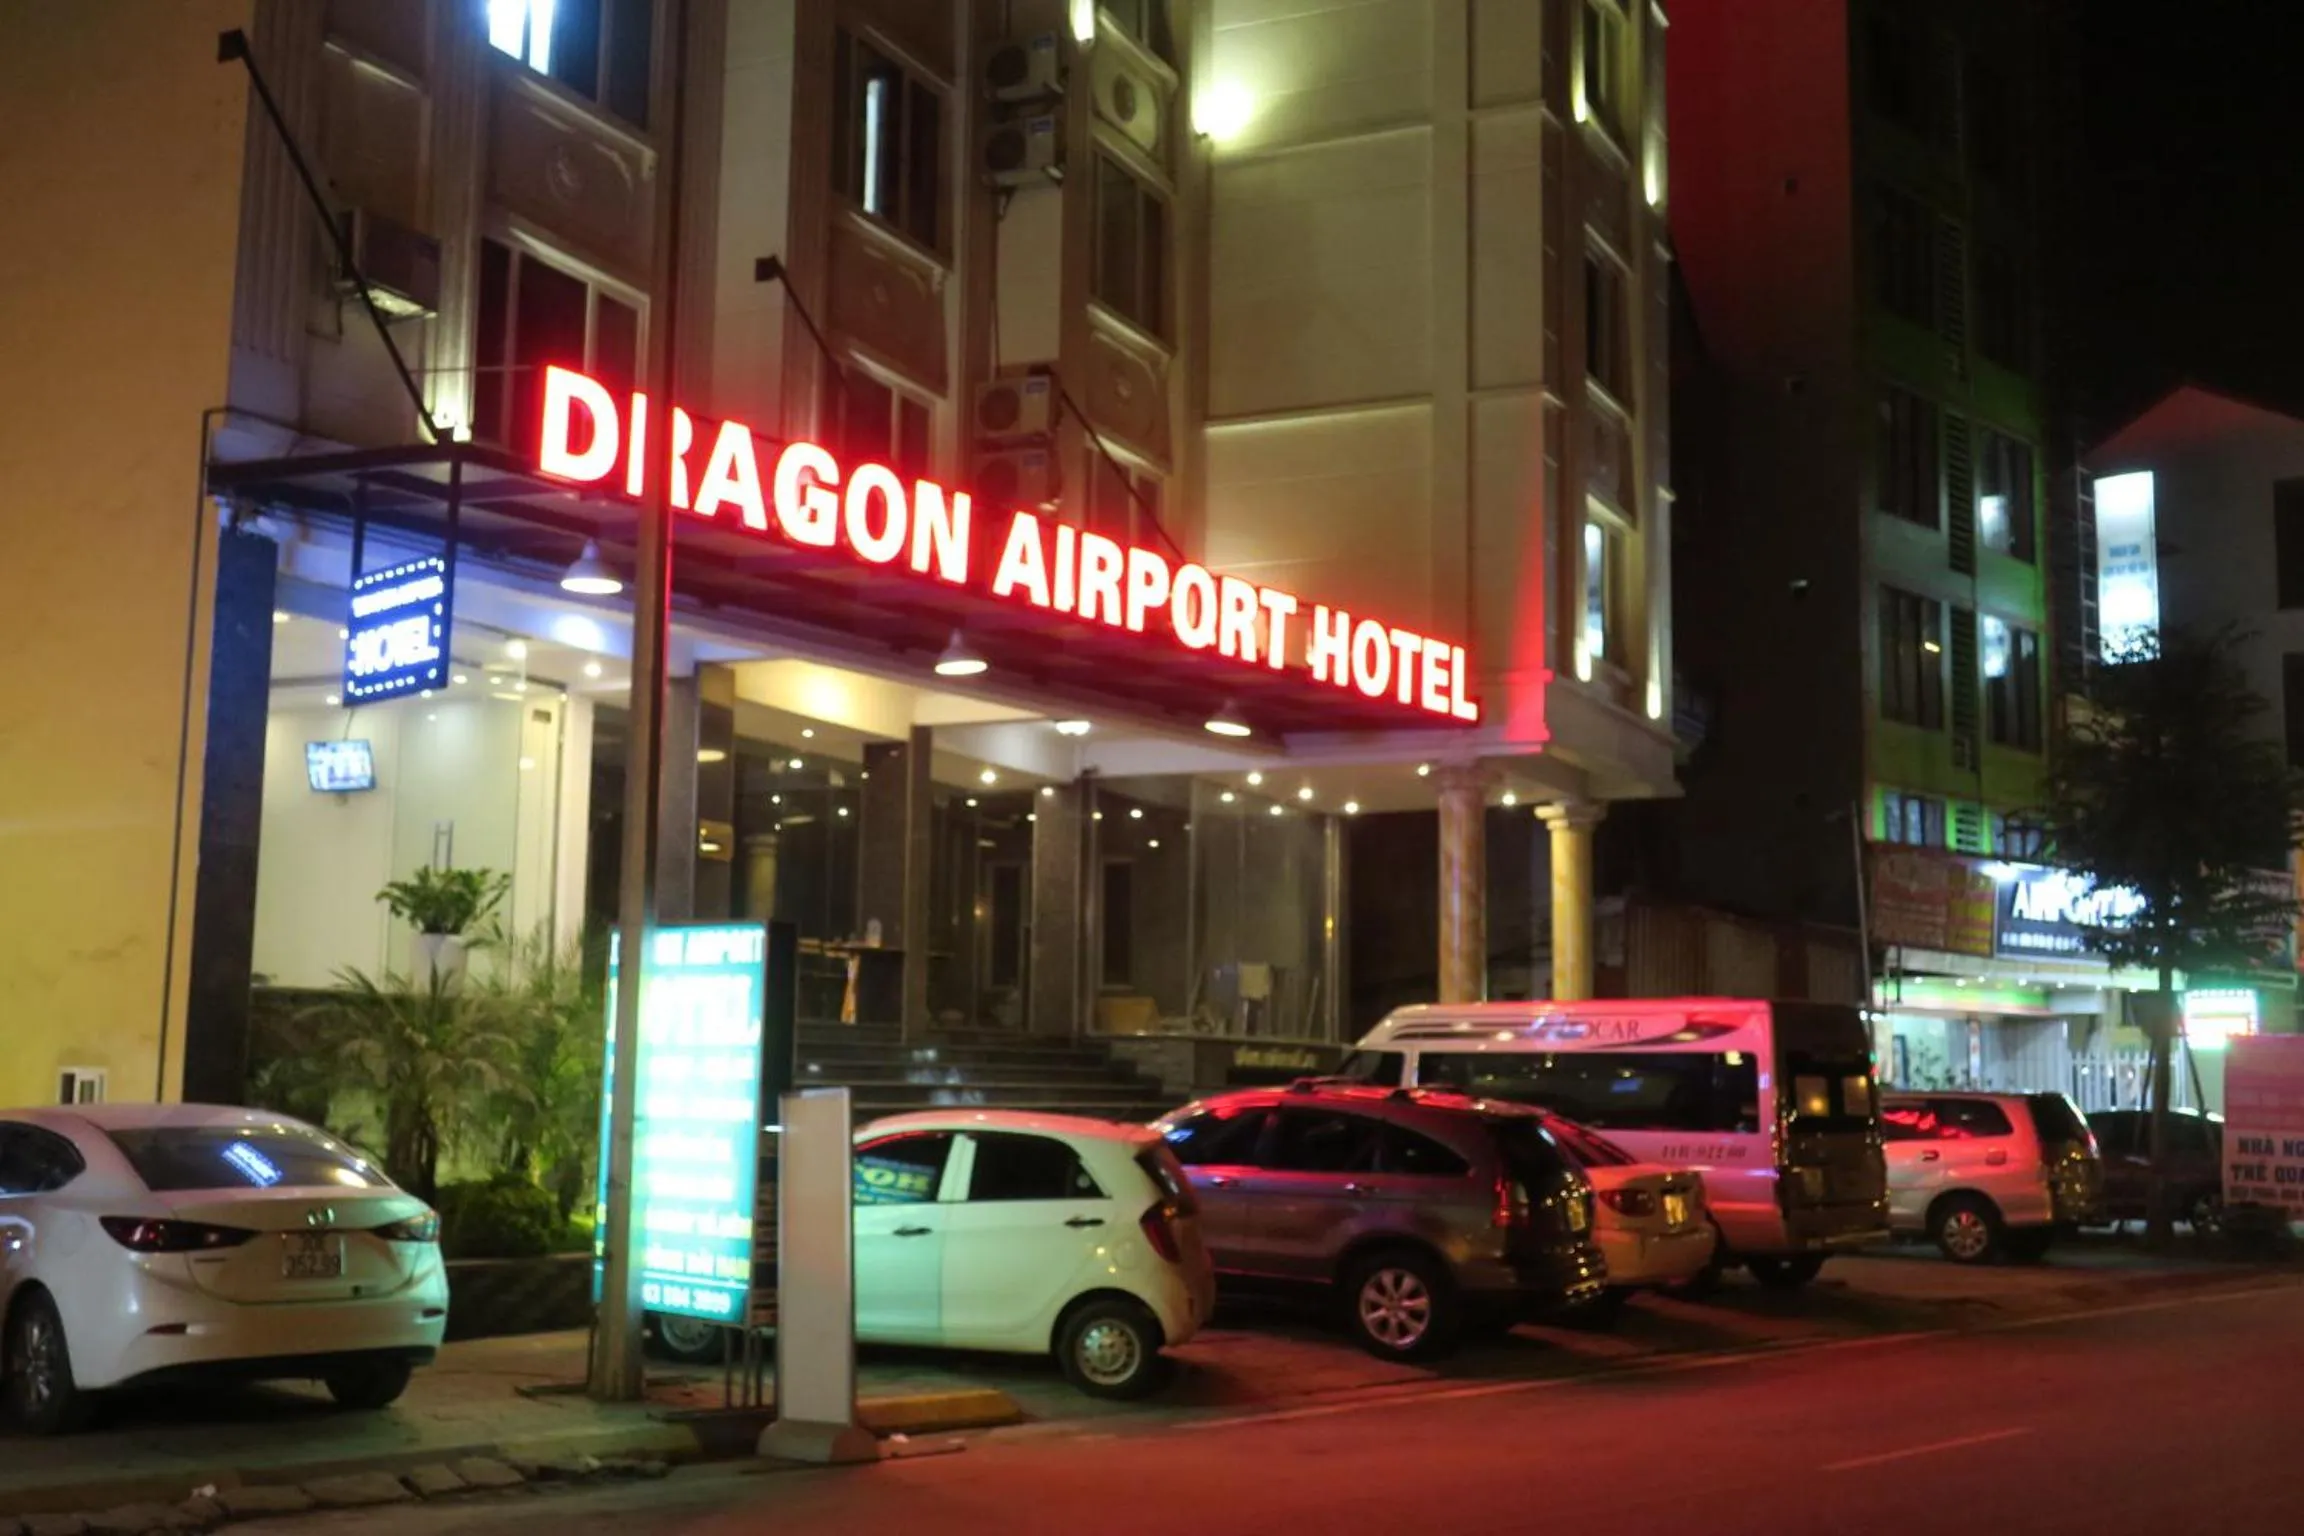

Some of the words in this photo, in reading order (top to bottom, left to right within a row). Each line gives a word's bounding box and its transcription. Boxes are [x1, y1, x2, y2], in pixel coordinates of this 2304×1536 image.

[538, 364, 973, 584] DRAGON
[991, 510, 1298, 670] AIRPORT
[1308, 604, 1479, 721] HOTEL
